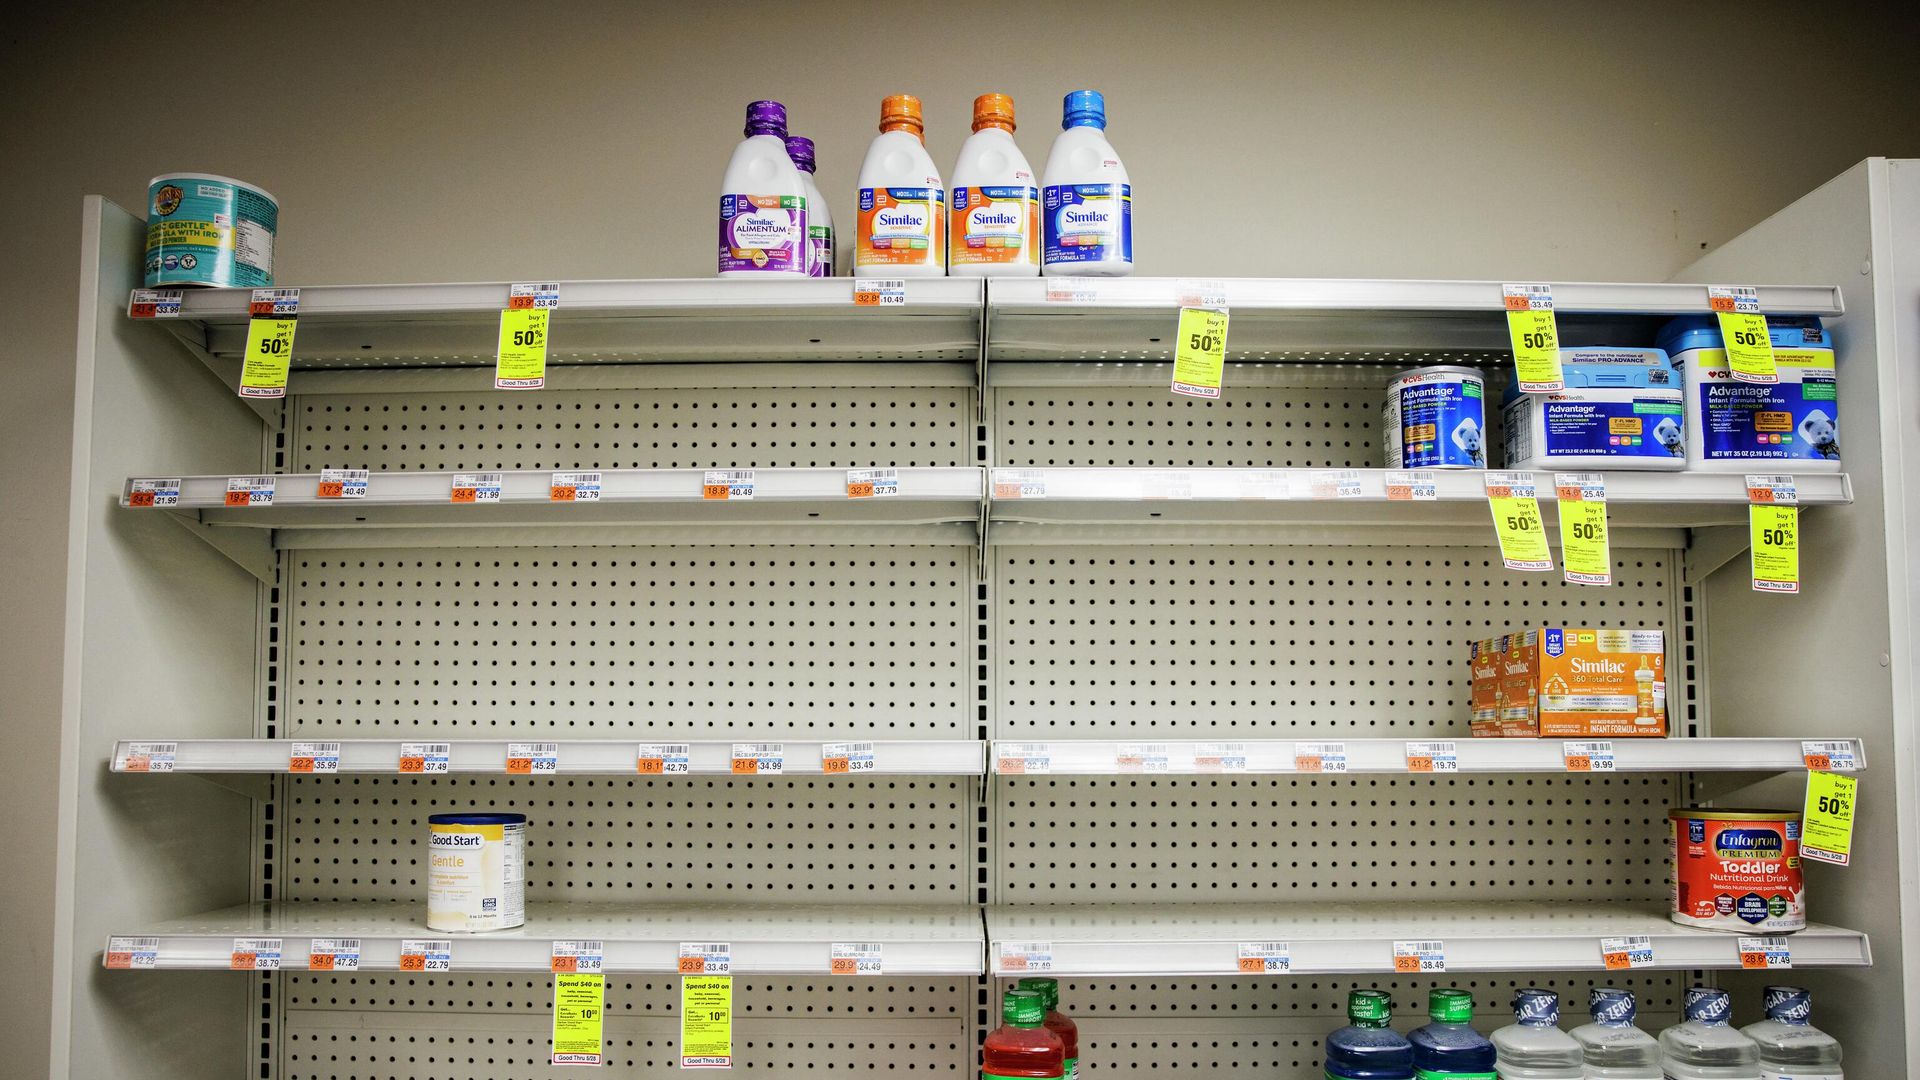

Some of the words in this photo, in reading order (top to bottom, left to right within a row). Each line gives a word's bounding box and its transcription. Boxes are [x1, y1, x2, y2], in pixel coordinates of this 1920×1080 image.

[880, 214, 922, 225] Similac
[974, 213, 1016, 224] Similac
[1066, 212, 1108, 222] Similac
[514, 330, 542, 346] 50%
[1191, 334, 1220, 351] 50%
[1524, 332, 1552, 349] 50%
[1735, 332, 1764, 346] 50%
[261, 339, 289, 354] 50%
[1403, 388, 1453, 399] Advantage
[1710, 386, 1770, 398] Advantage
[1508, 517, 1537, 530] 50%
[1574, 523, 1602, 539] 50%
[1764, 529, 1793, 545] 50%
[1475, 665, 1496, 680] Similac
[1505, 662, 1529, 675] Similac
[1571, 658, 1625, 673] Similac
[1590, 725, 1610, 733] INFANT
[1834, 781, 1848, 789] buy
[1818, 796, 1849, 815] 50%
[432, 835, 451, 845] Good
[454, 836, 479, 846] Start
[1722, 834, 1778, 848] Enfagrow
[432, 855, 464, 867] Gentle
[1720, 861, 1780, 874] Toddler
[1710, 874, 1764, 882] Nutritional
[1606, 996, 1632, 1020] ZERO
[1707, 993, 1729, 1018] ZERO
[1785, 1000, 1810, 1020] ZERO
